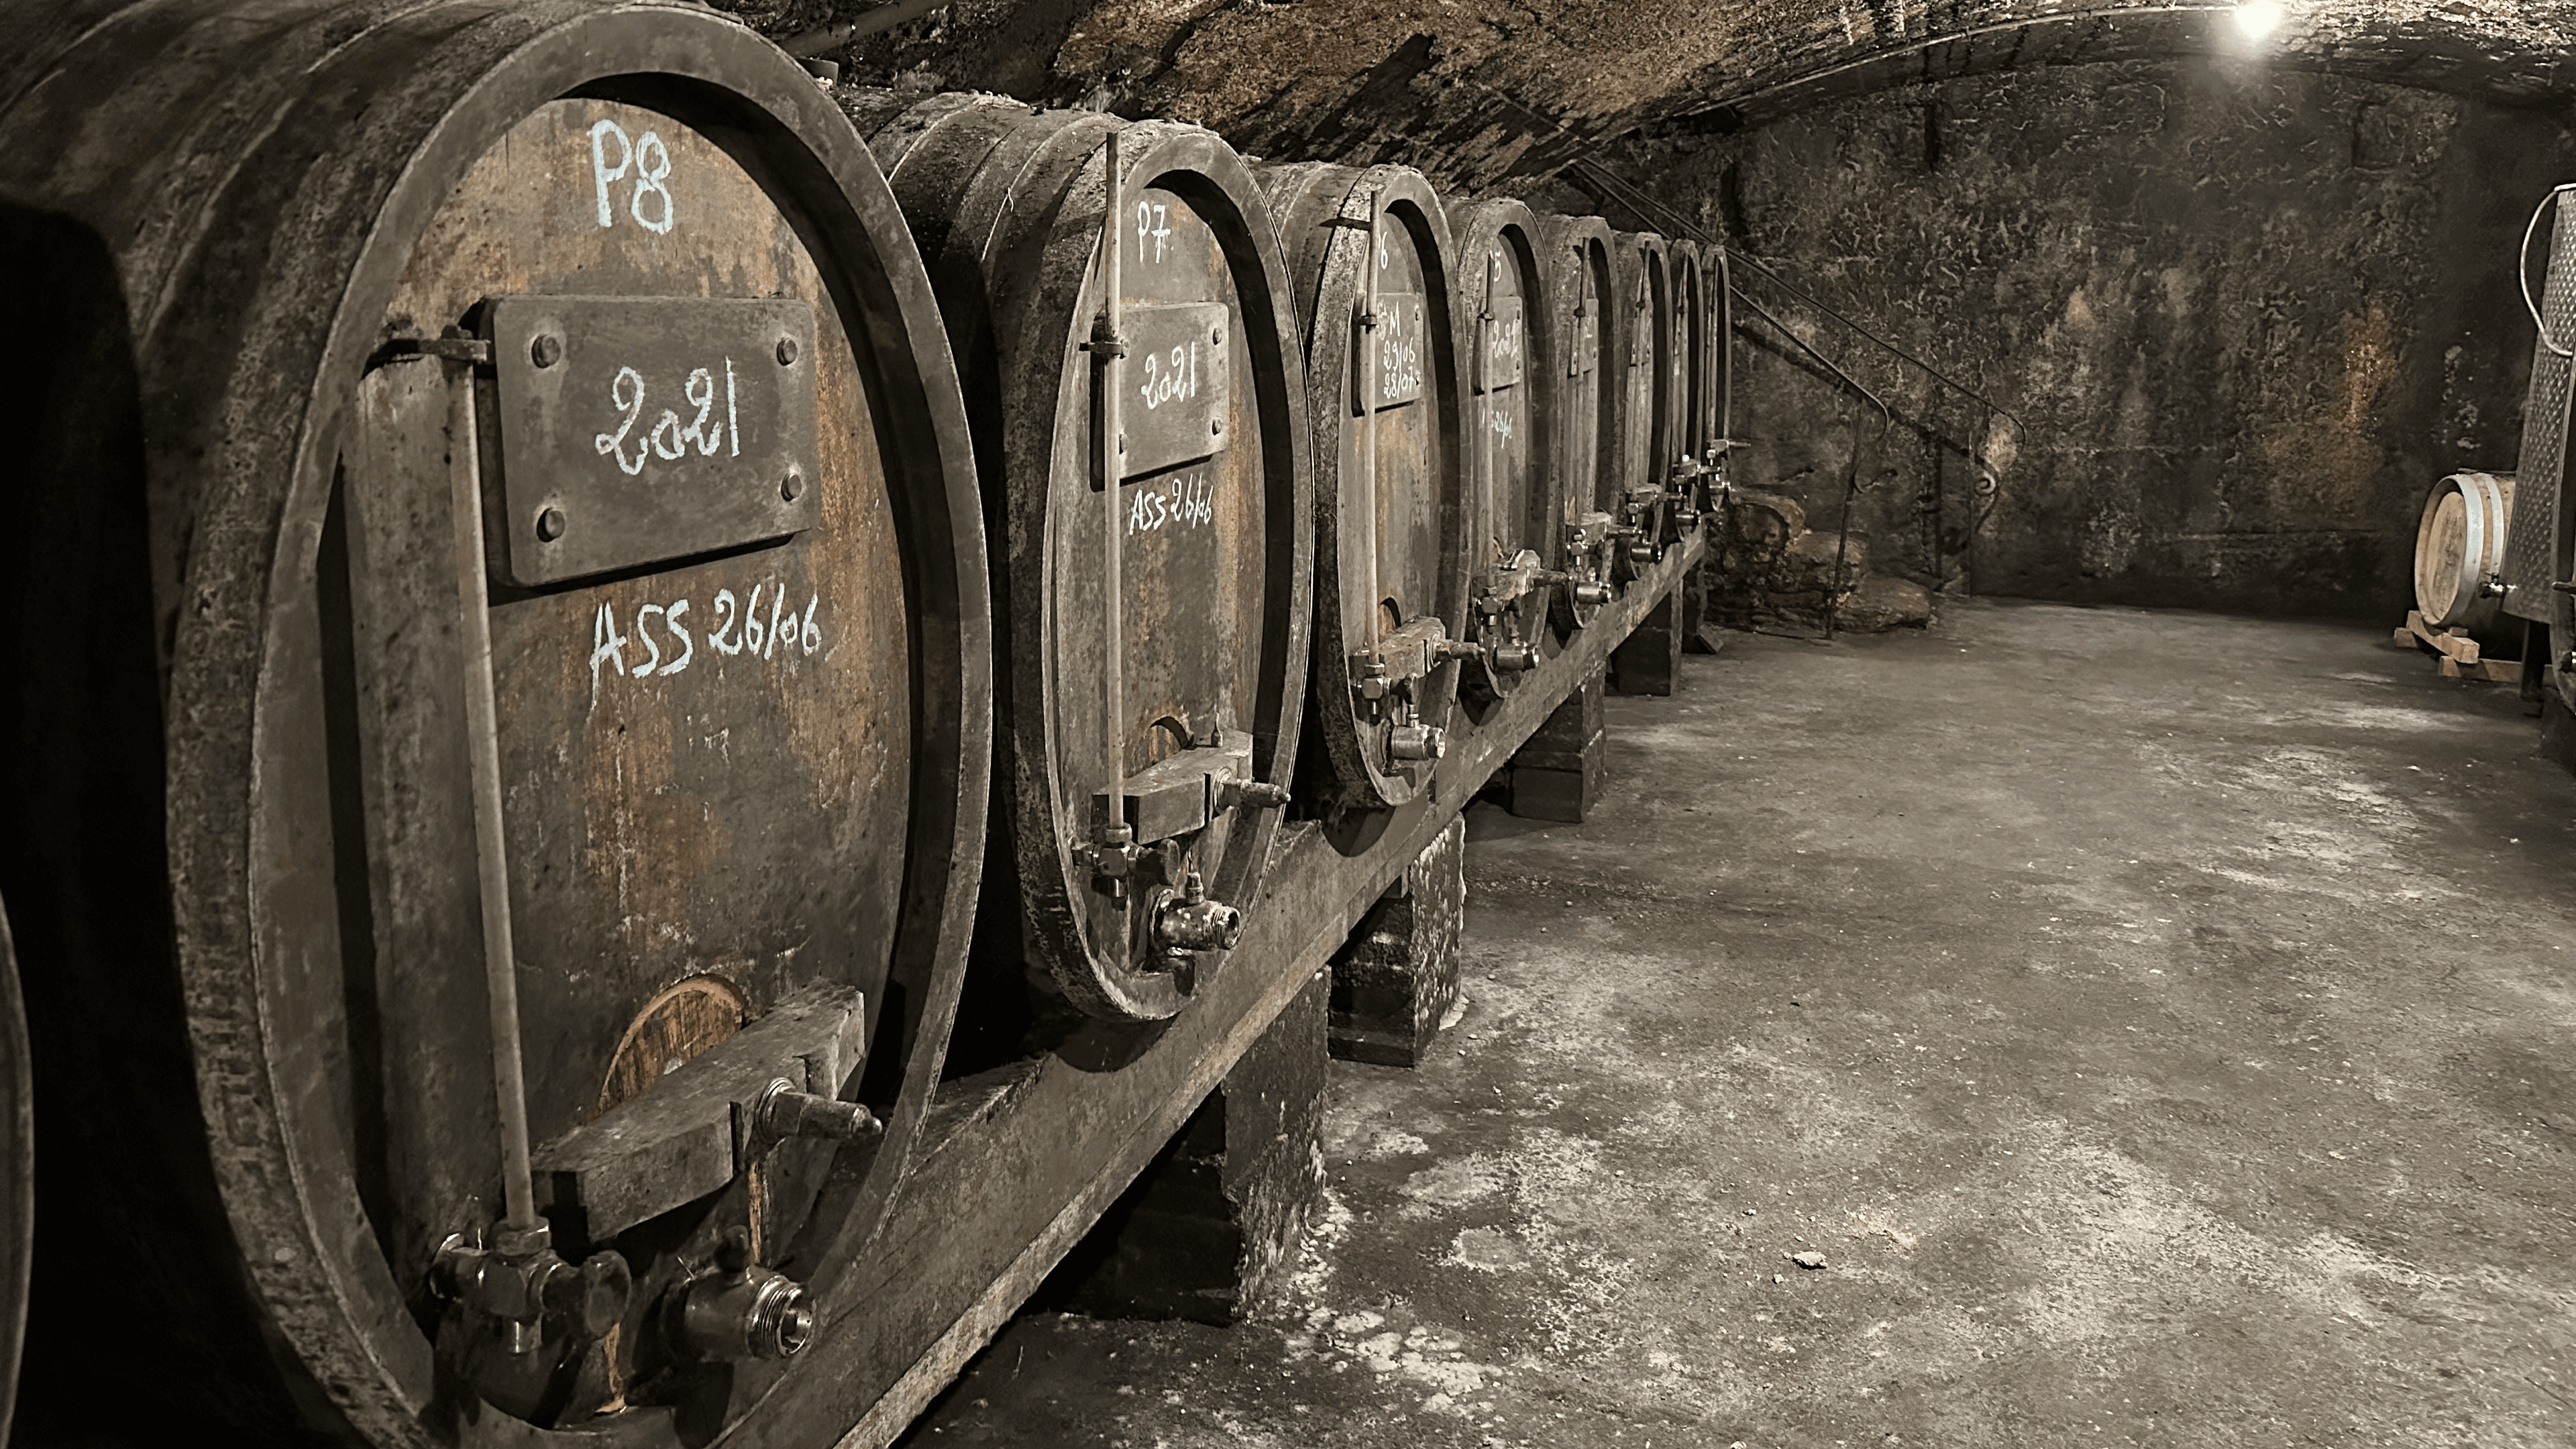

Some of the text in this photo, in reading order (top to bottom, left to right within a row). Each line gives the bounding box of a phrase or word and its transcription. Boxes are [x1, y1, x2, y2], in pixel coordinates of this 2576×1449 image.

[586, 119, 674, 235] P8
[1138, 201, 1171, 264] P7
[1378, 231, 1388, 270] 6
[1489, 250, 1501, 282] 5
[1141, 341, 1195, 409] 2021
[1383, 337, 1415, 374] 29/06
[1383, 366, 1414, 399] 28/07
[596, 356, 739, 475] 2021
[1129, 472, 1214, 535] ASS 26/06
[590, 582, 822, 708] ASS 26/06
